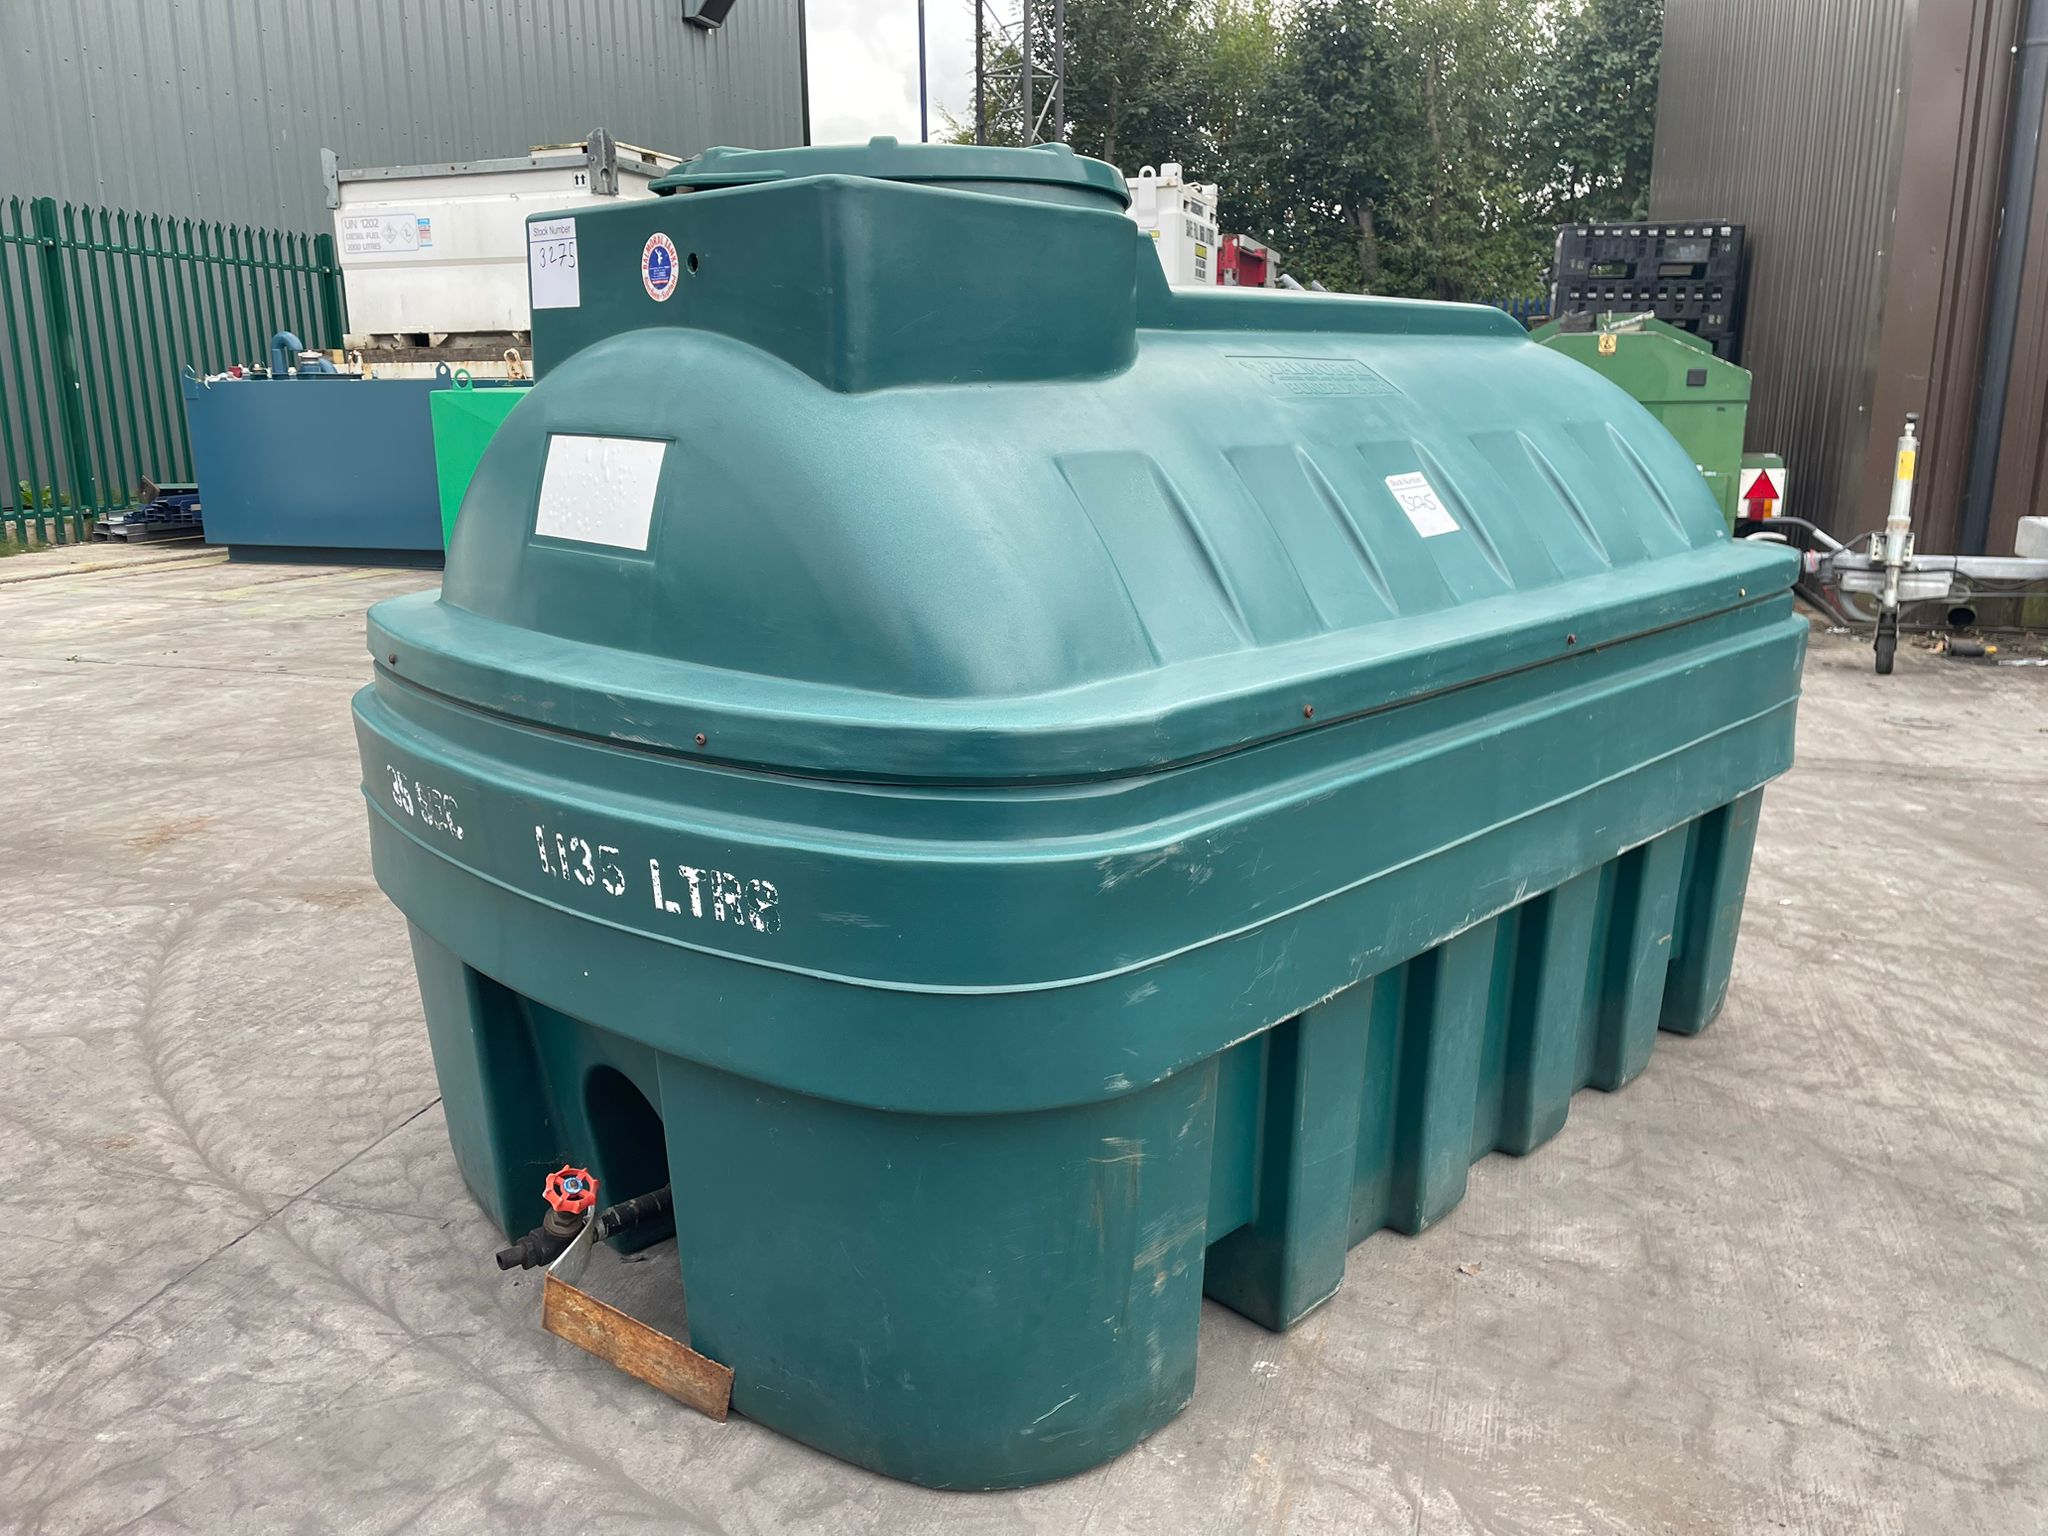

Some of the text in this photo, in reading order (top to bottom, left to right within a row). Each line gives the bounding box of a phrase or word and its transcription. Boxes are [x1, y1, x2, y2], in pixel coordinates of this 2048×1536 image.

[344, 218, 380, 229] UN 1202
[533, 225, 571, 238] Stock Number
[540, 241, 576, 268] 3275
[642, 234, 678, 270] BALMORAL TANKS
